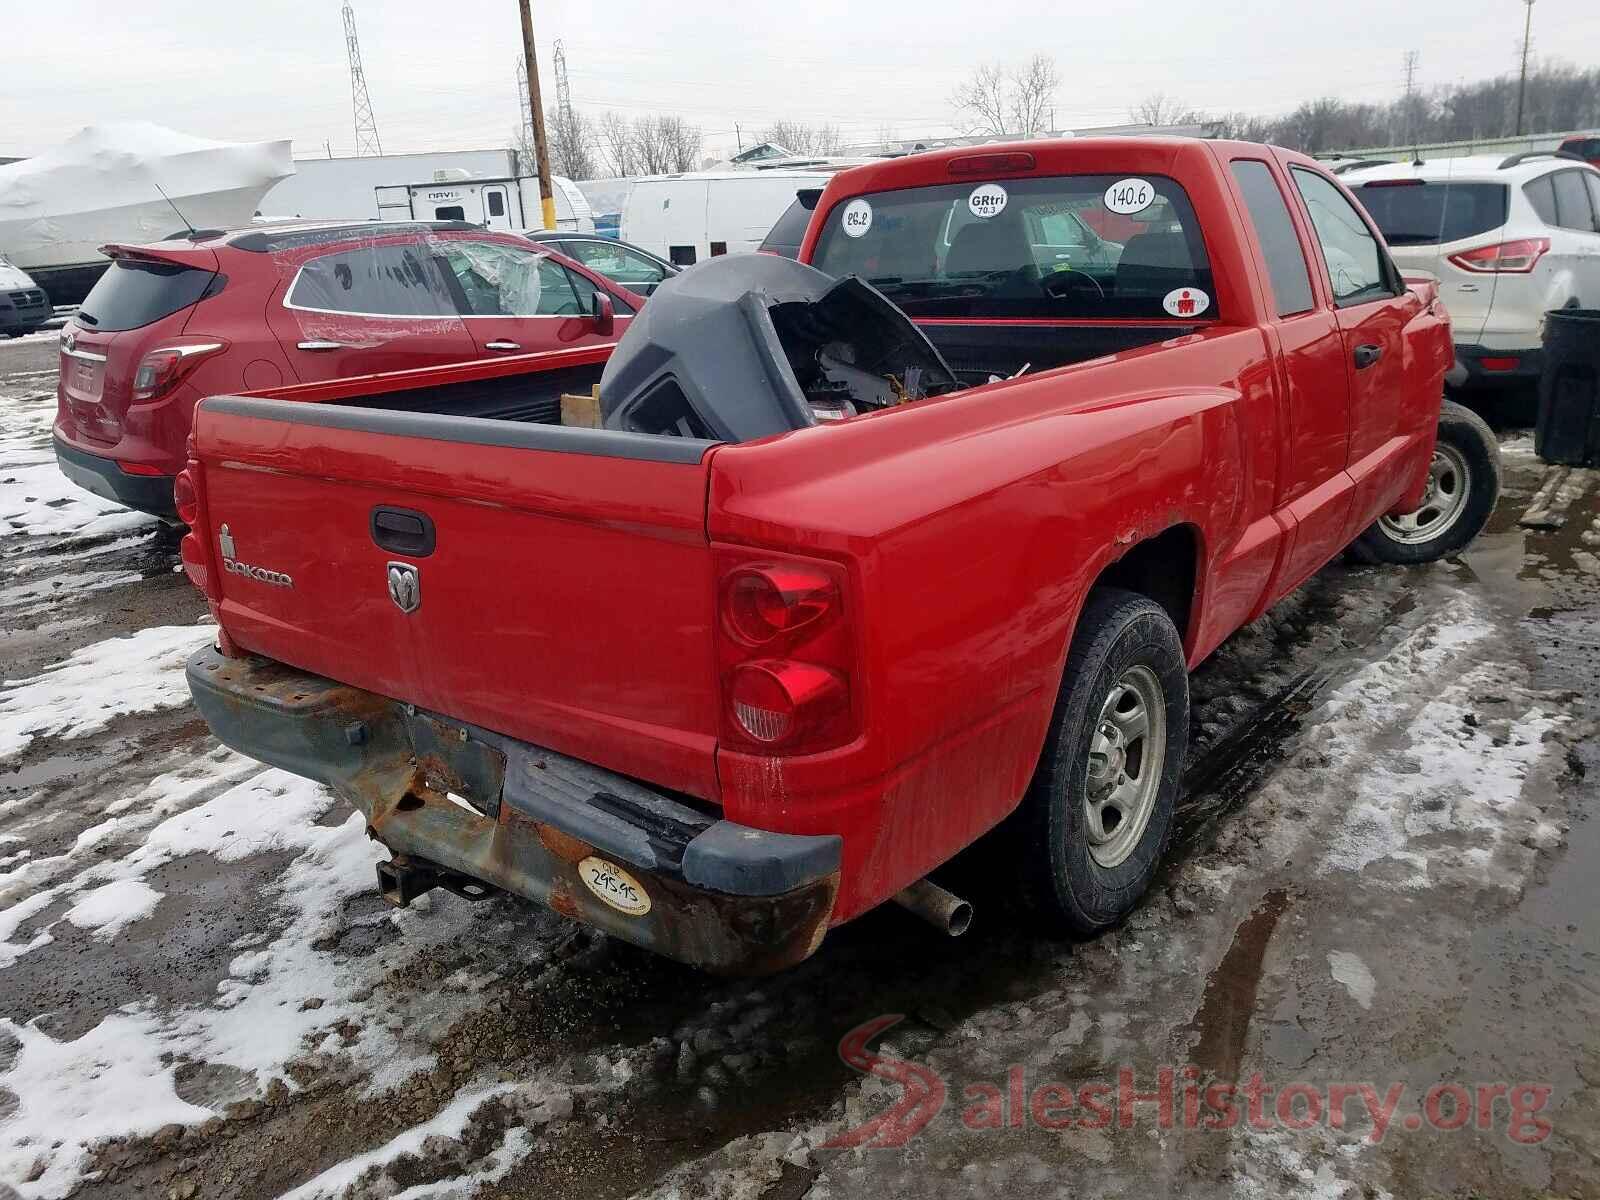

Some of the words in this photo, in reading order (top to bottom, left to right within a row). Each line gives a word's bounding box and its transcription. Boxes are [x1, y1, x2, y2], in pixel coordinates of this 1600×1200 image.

[971, 193, 1005, 207] GRtri
[1111, 185, 1147, 207] 140.6
[977, 206, 996, 215] 70.3
